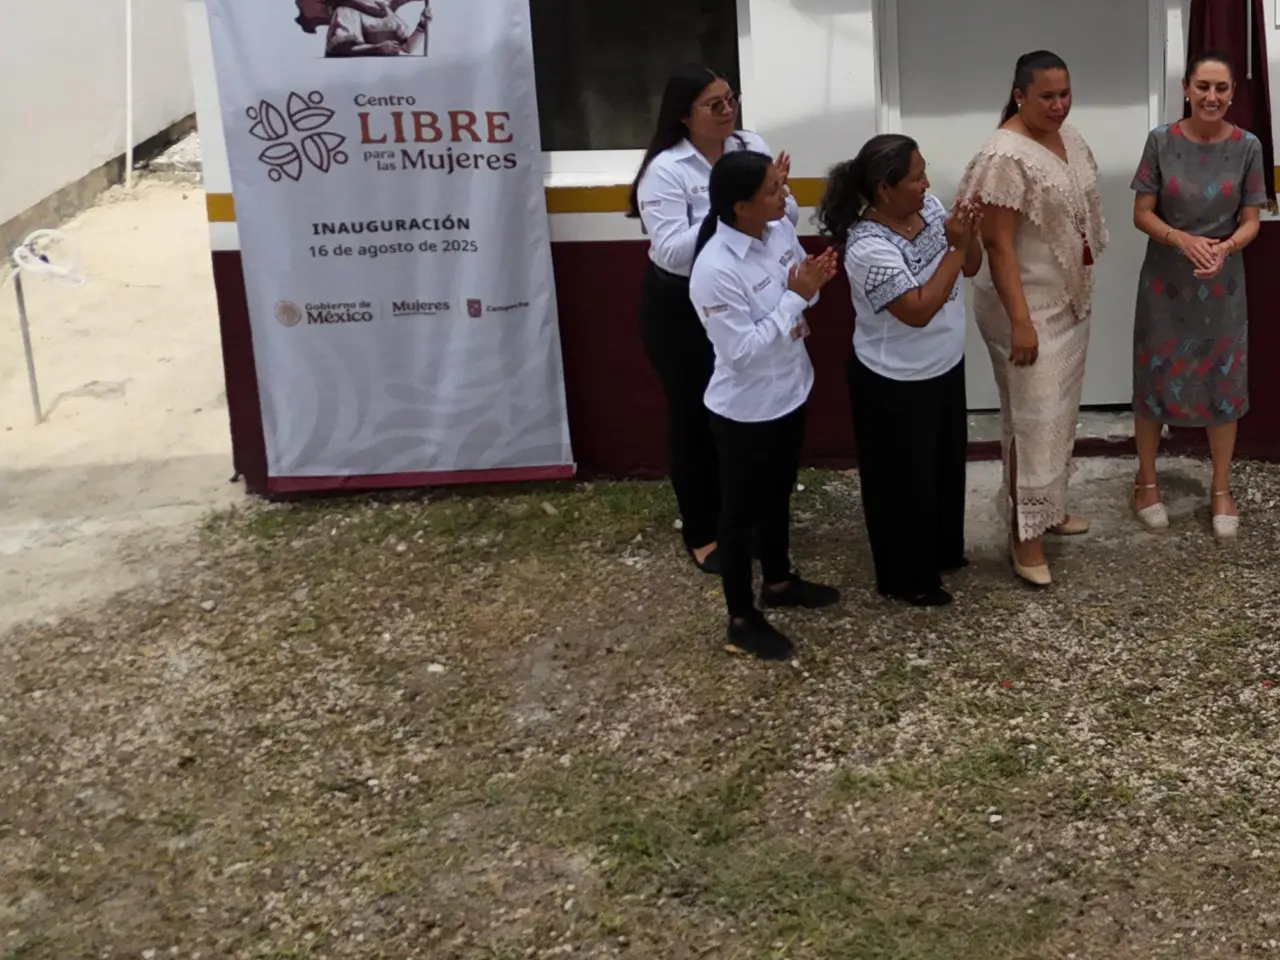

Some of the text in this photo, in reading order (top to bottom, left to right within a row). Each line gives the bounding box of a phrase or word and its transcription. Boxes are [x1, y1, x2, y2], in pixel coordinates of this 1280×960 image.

[354, 93, 416, 107] Centro
[357, 110, 514, 145] LIBRE
[363, 149, 395, 161] para
[376, 147, 518, 175] las Mujeres
[312, 214, 471, 235] INAUGURACIÓN
[309, 240, 478, 258] 16 de agosto de 2025
[305, 300, 371, 312] Gobierno de
[392, 299, 450, 312] Mujeres
[307, 309, 373, 324] México
